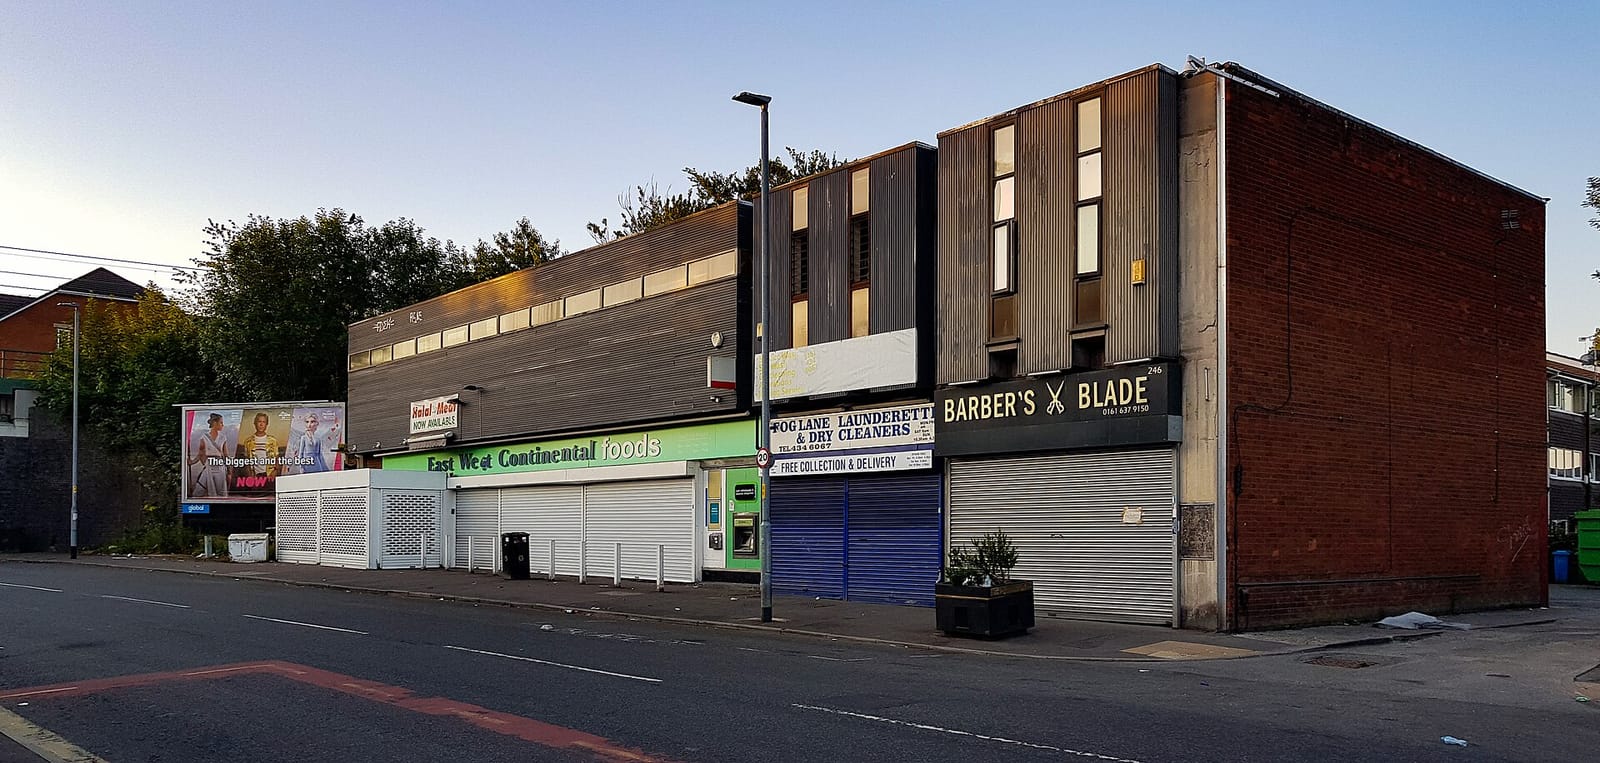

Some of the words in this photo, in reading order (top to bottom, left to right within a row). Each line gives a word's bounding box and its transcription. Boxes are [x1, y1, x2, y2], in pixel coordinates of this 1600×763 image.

[1147, 366, 1163, 375] 246
[944, 389, 1036, 423] BARBER'S
[1078, 376, 1148, 409] BLADE
[412, 403, 433, 419] Halal
[1102, 408, 1118, 416] 0161
[1119, 406, 1131, 414] 637
[1132, 405, 1149, 413] 9150
[413, 421, 427, 430] NOW
[427, 416, 456, 428] AVAILABLE
[772, 420, 797, 433] FOG
[798, 417, 830, 431] LANE
[796, 432, 806, 444] &
[808, 430, 834, 443] DRY
[838, 423, 911, 441] CLEANERS
[427, 456, 455, 472] East
[498, 440, 597, 467] Continental
[602, 433, 661, 460] foods
[758, 453, 767, 462] 20
[208, 457, 224, 466] The
[225, 456, 257, 468] biggest
[258, 456, 276, 465] and
[278, 456, 293, 465] the
[294, 456, 315, 465] best
[781, 462, 799, 473] FREE
[800, 459, 846, 473] COLLECTION
[848, 458, 854, 470] &
[856, 456, 896, 470] DELIVERY
[236, 476, 267, 488] NOW
[188, 504, 205, 513] global
